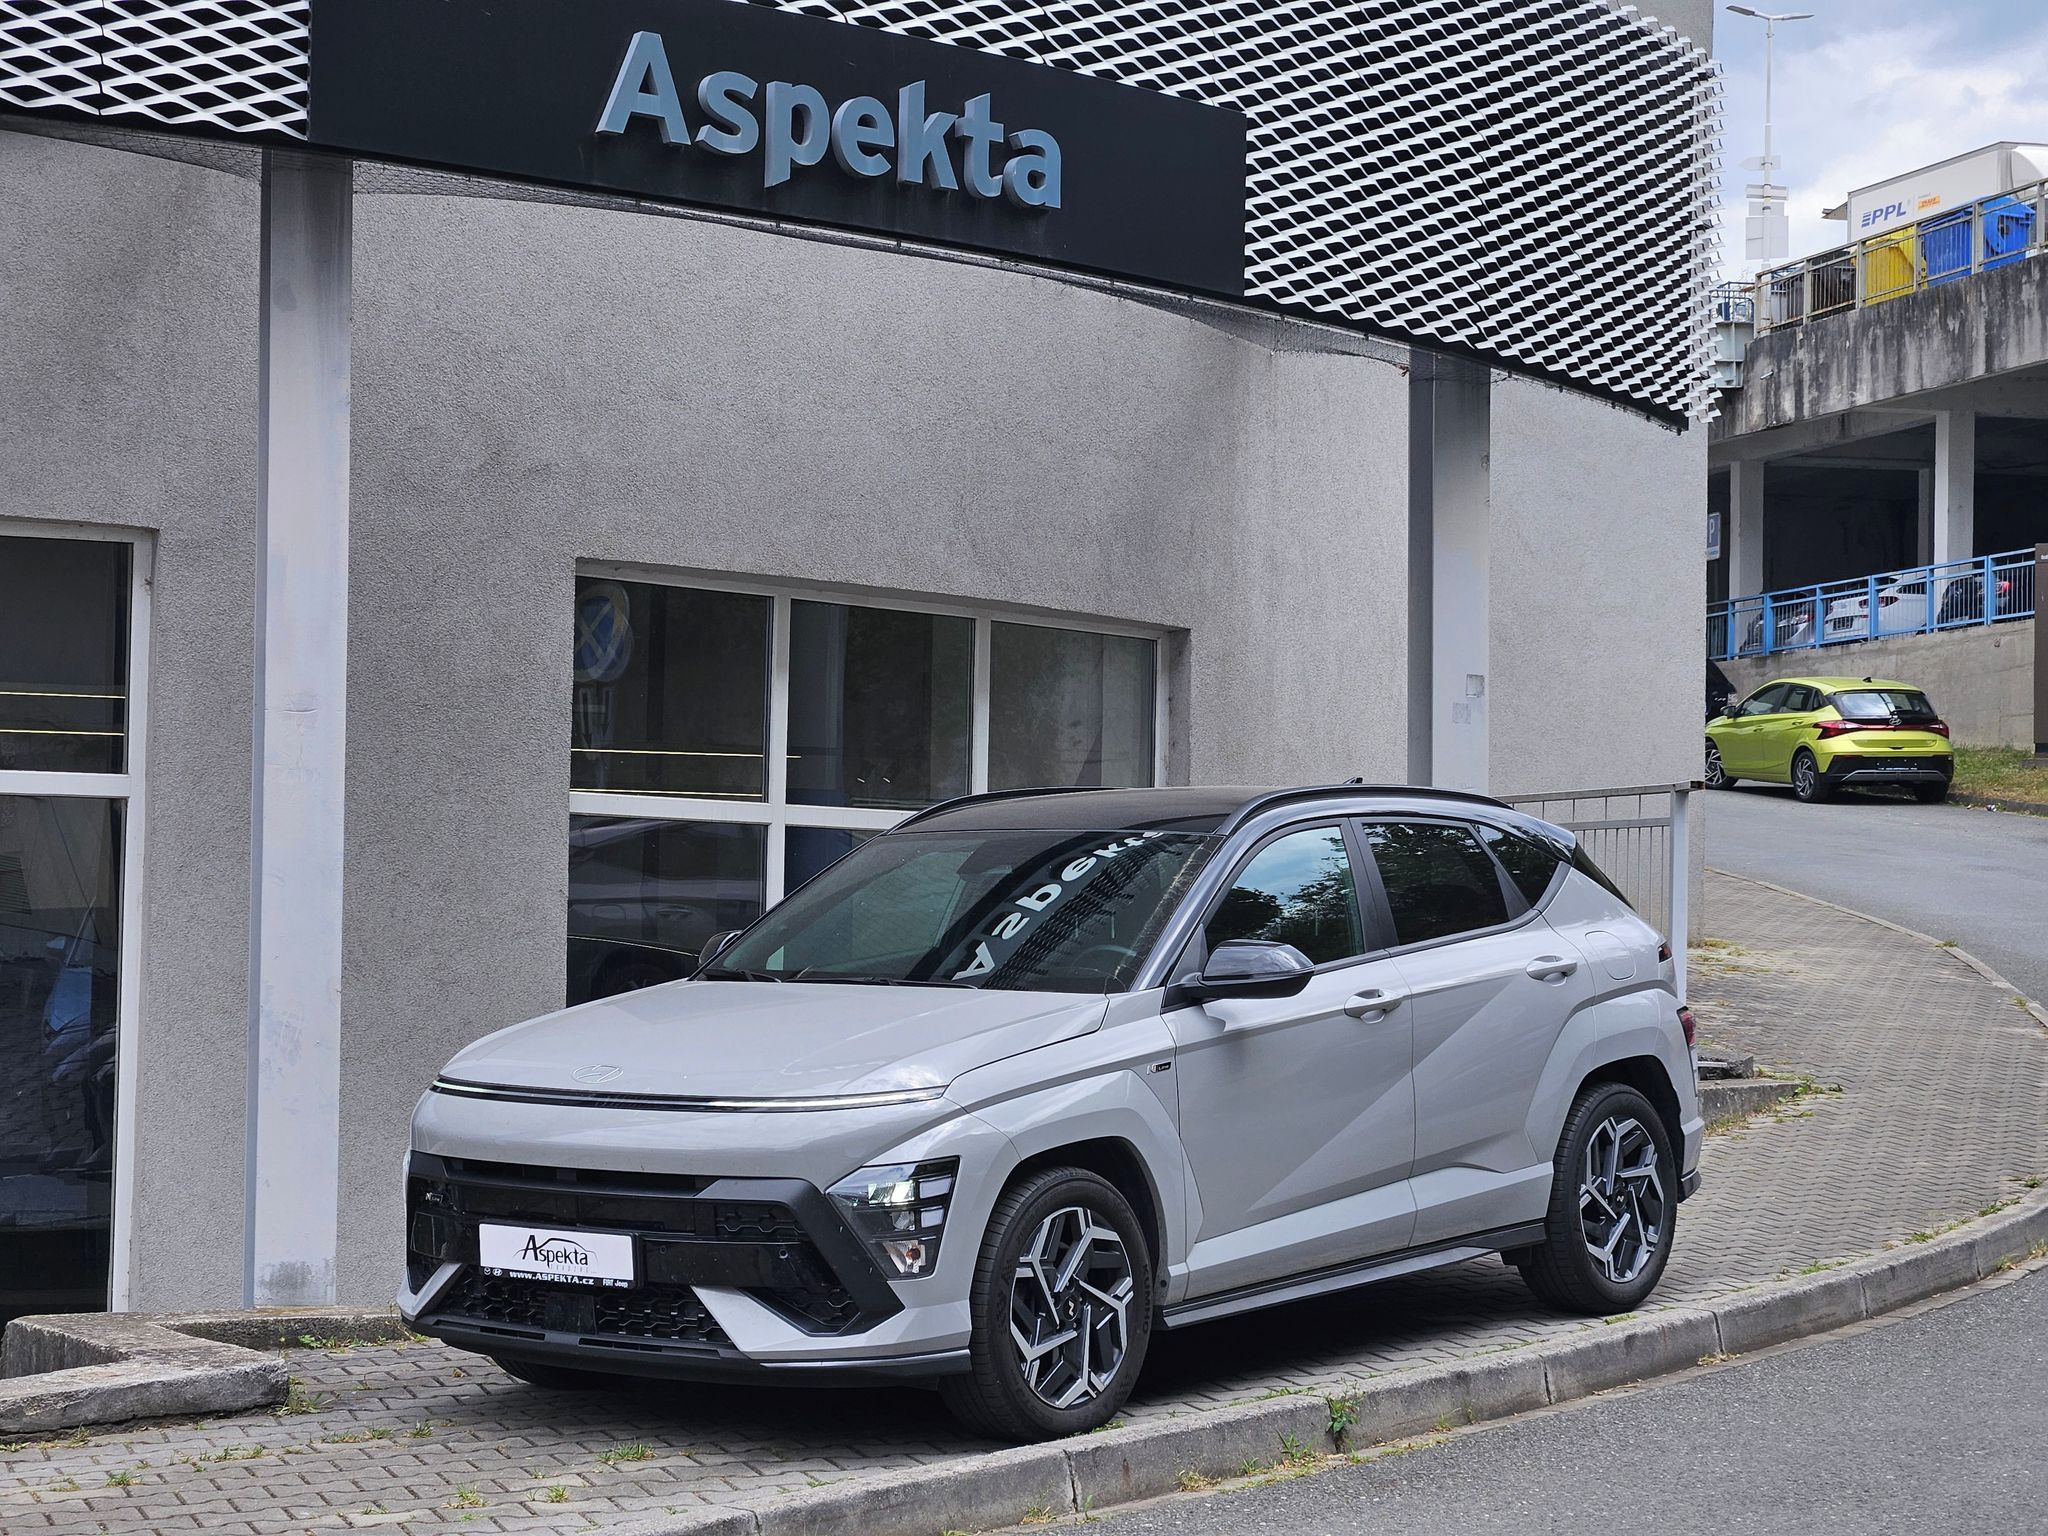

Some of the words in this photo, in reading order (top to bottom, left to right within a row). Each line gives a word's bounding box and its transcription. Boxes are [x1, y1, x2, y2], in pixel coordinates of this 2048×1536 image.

[595, 30, 1062, 210] Aspekta
[1871, 201, 1906, 224] PPL
[522, 1234, 588, 1269] Aspekta
[509, 1271, 595, 1285] www.ASPEKTA.cz
[1142, 1264, 1151, 1335] KUMHO
